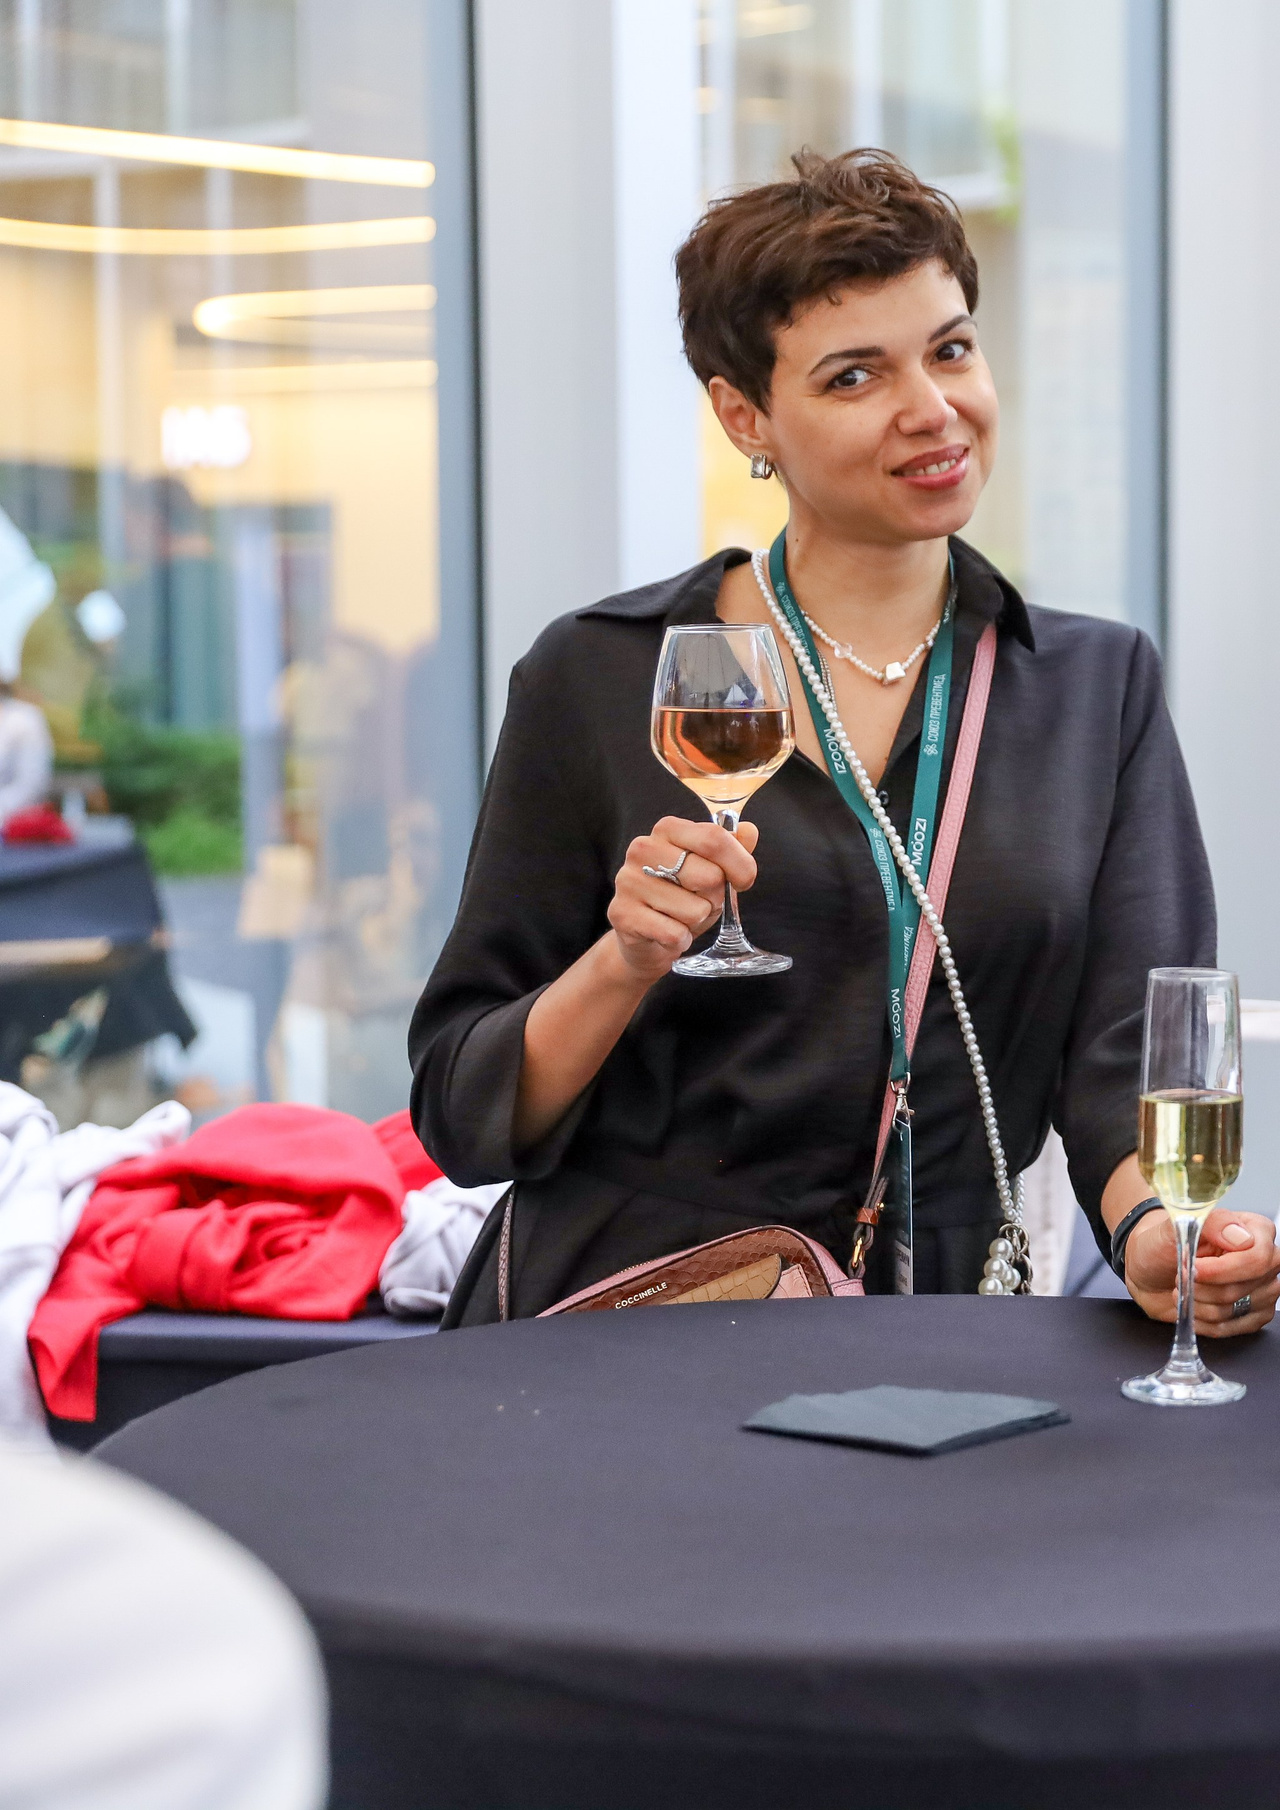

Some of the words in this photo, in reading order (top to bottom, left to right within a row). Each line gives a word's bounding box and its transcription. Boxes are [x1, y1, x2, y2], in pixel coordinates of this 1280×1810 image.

[781, 594, 796, 618] СОЮЗ
[930, 673, 947, 719] ПРЕВЕНТМЕД
[928, 720, 940, 741] СОЮЗ
[875, 839, 888, 862] СОЮЗ
[615, 1281, 668, 1310] COCCINELLE
